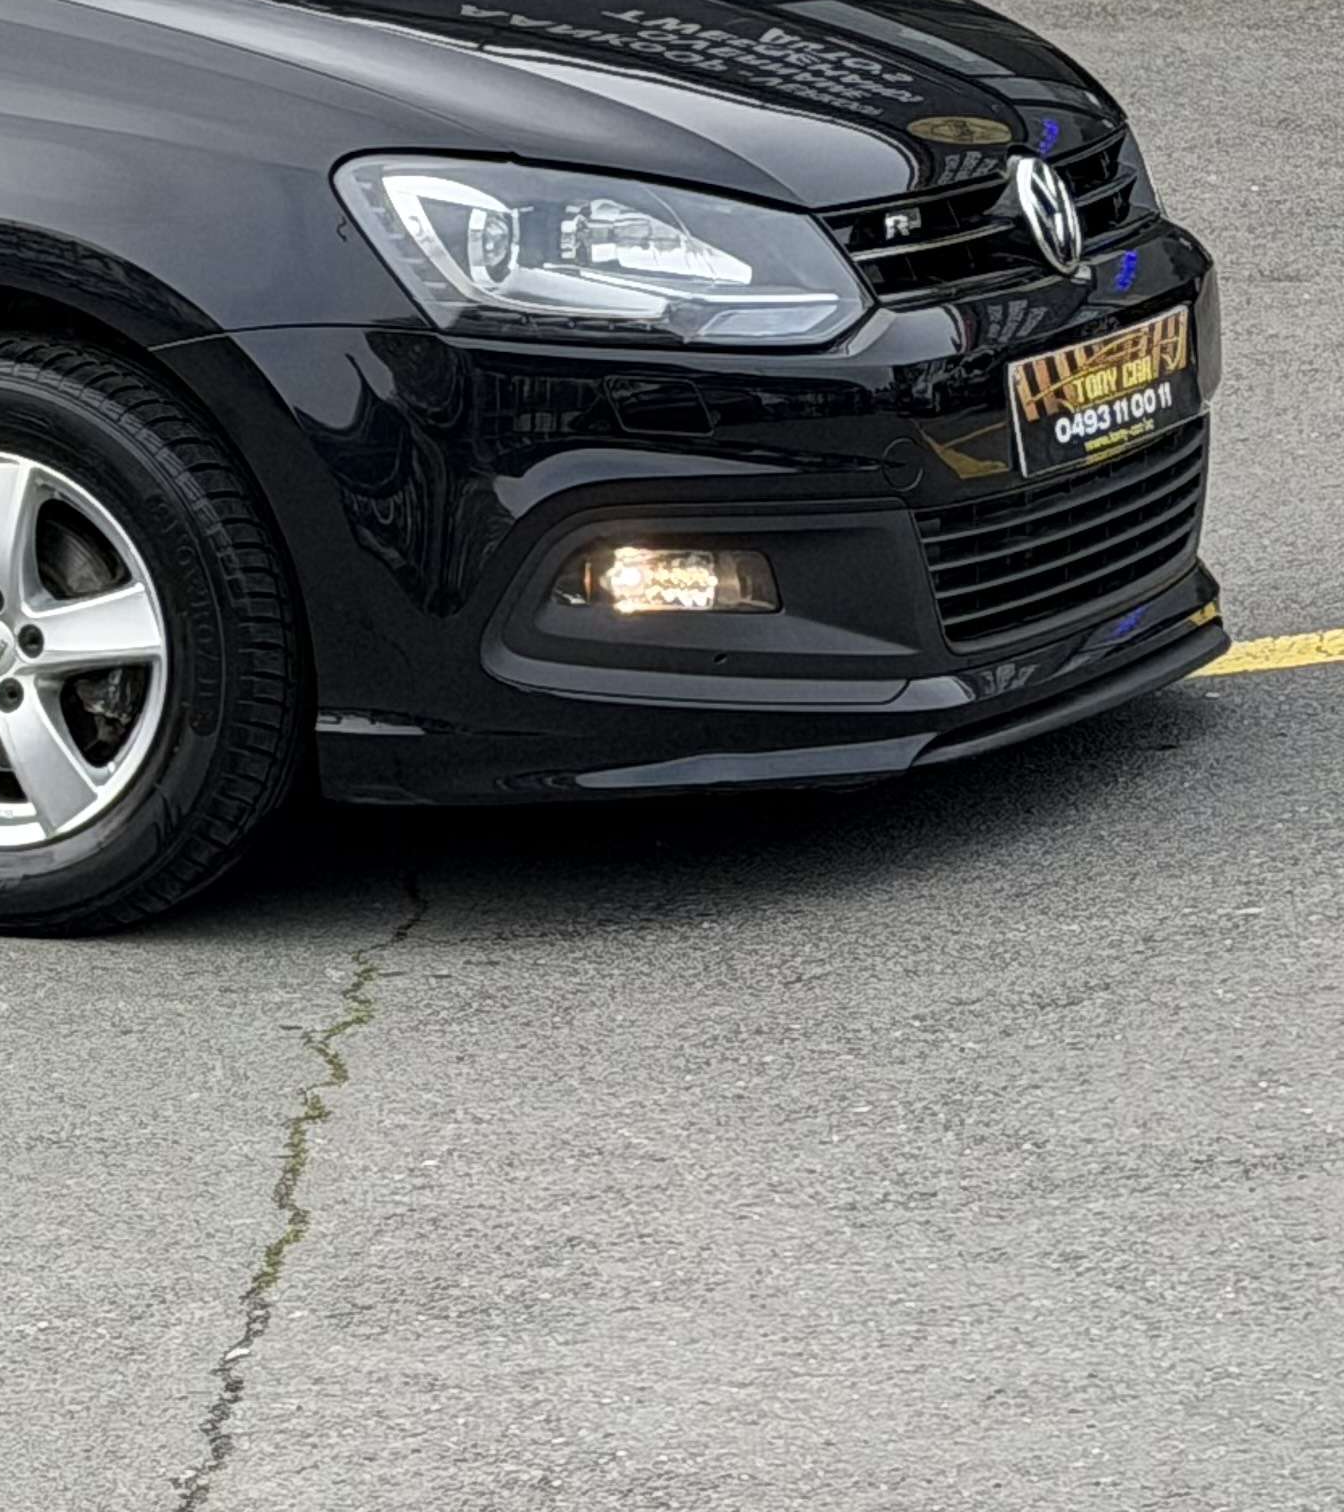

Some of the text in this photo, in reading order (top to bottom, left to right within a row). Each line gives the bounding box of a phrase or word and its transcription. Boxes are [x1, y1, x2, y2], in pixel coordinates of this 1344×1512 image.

[1073, 356, 1154, 404] TONY CAR
[1055, 382, 1173, 443] 0493 11 00 11
